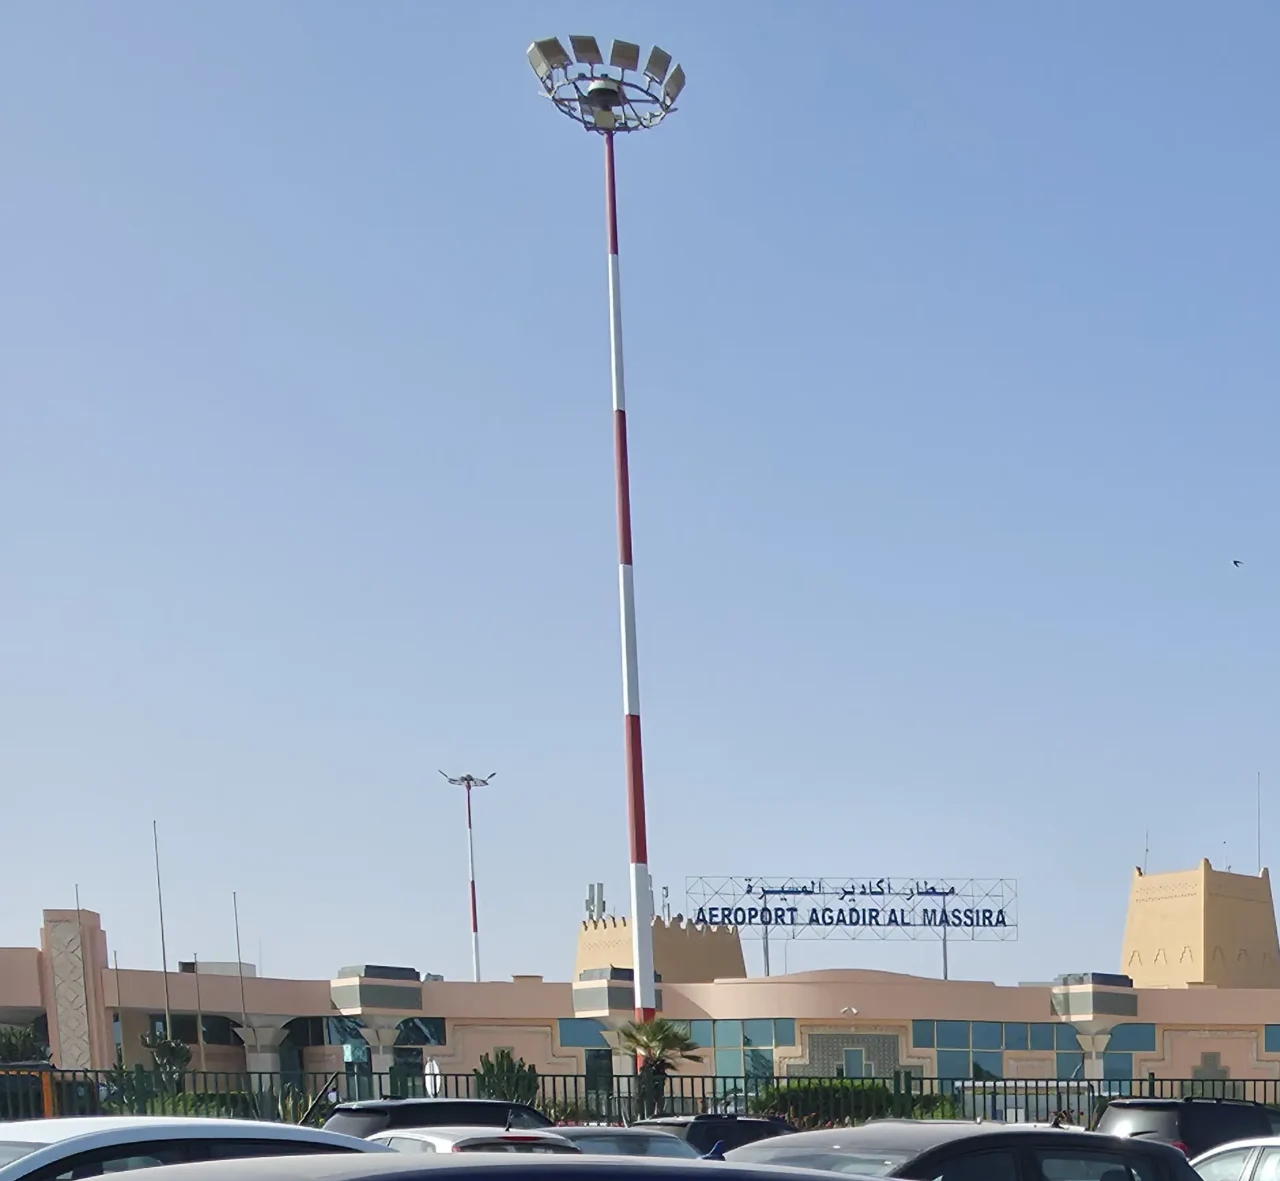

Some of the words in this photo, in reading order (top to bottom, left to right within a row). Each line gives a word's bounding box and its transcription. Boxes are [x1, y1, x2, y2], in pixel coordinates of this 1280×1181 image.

[744, 878, 822, 900] المسيرة
[906, 880, 955, 901] مطار
[695, 907, 798, 927] AEROPORT
[809, 907, 879, 927] AGADIR
[888, 908, 911, 927] AL
[923, 908, 1007, 928] MASSIRA
